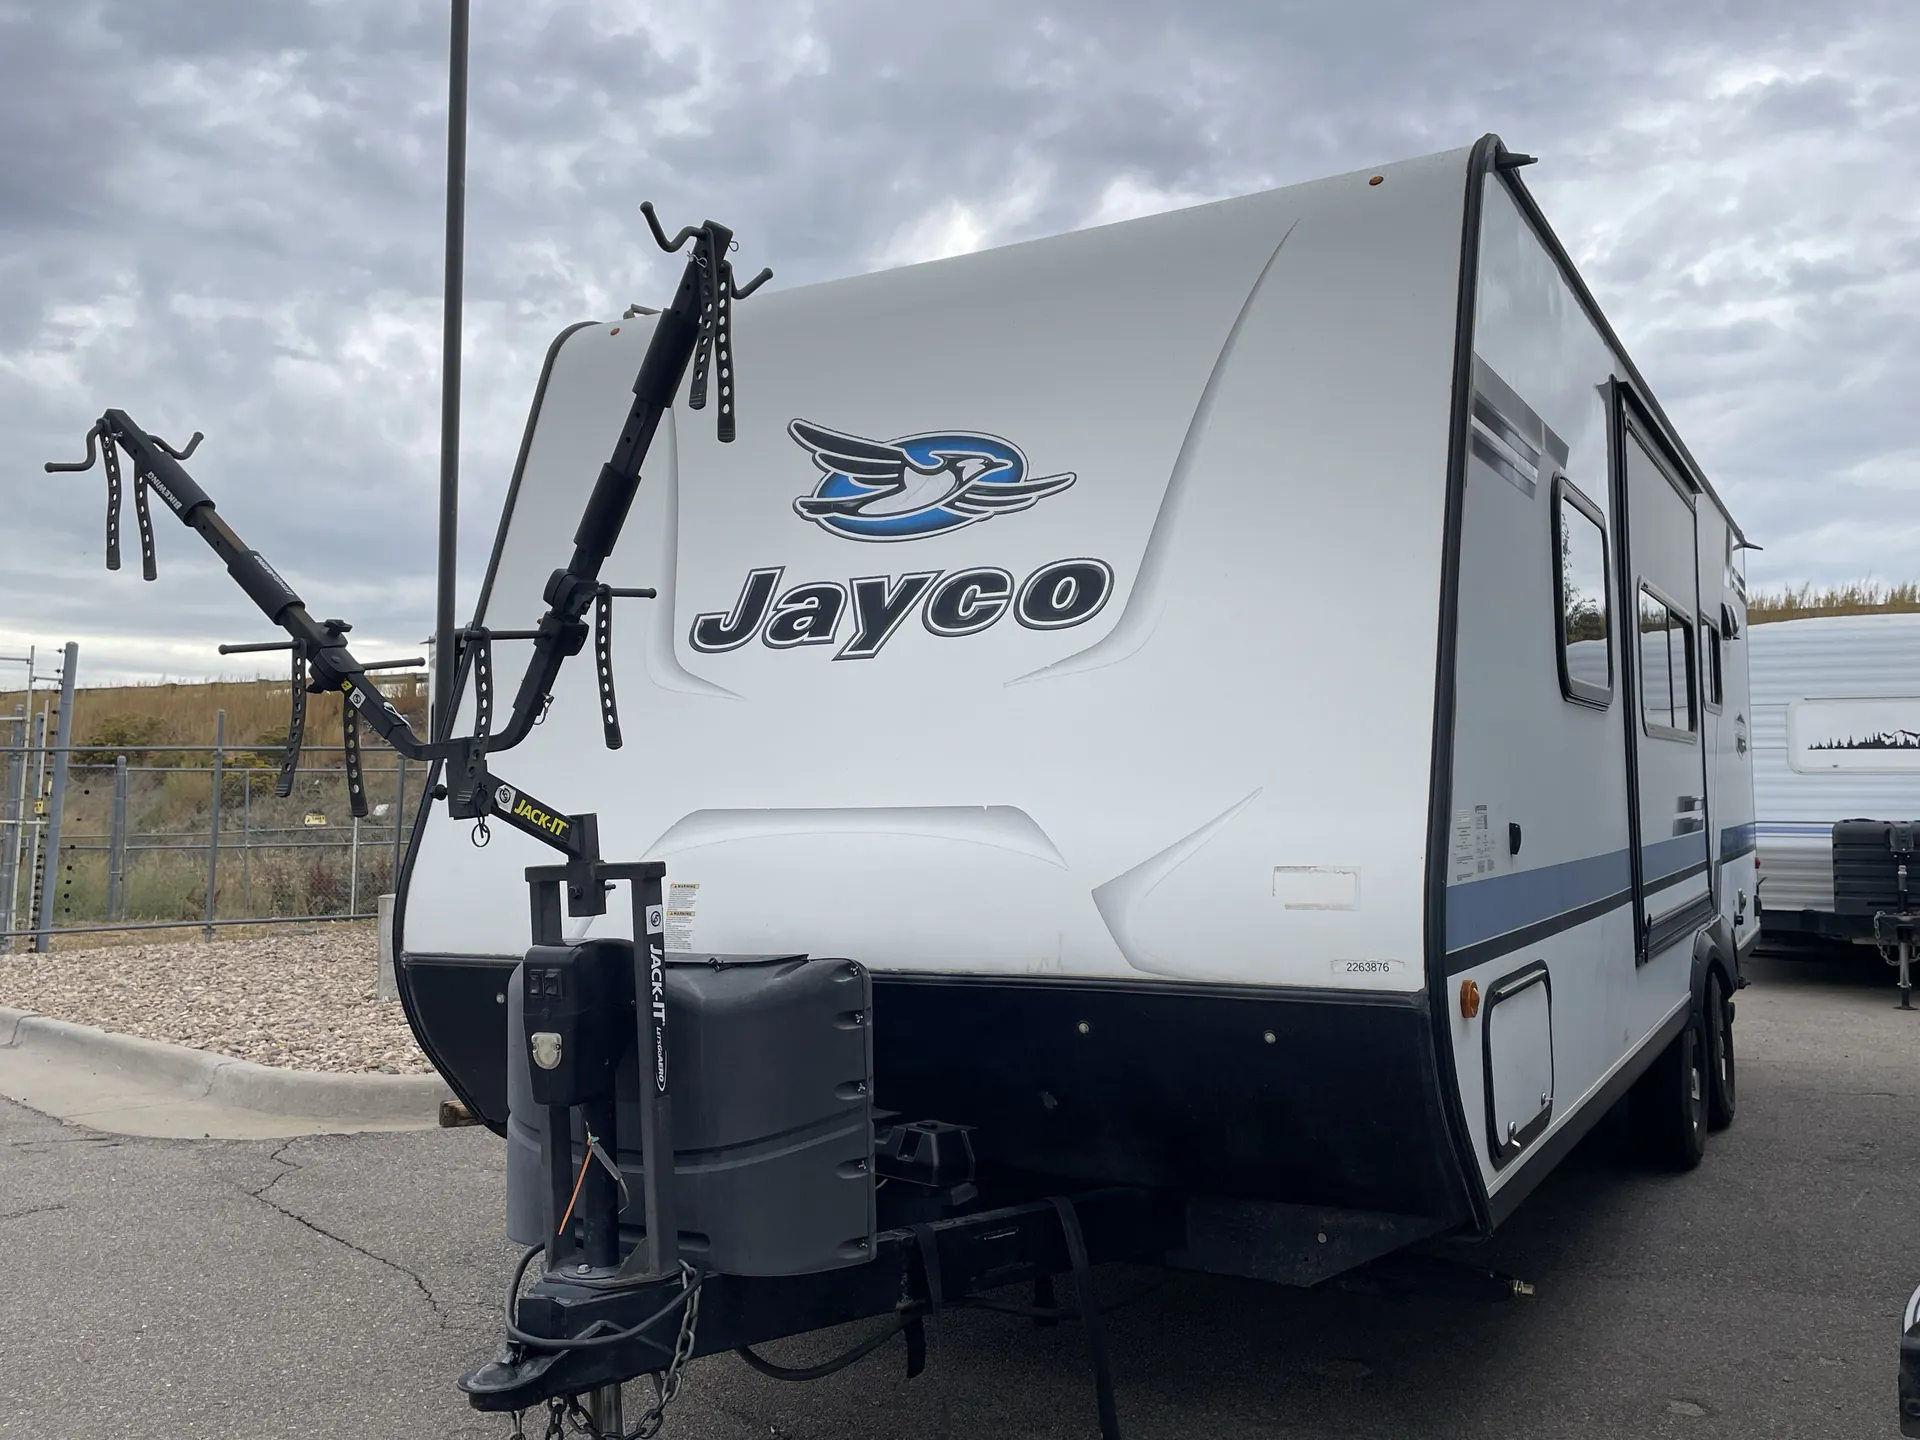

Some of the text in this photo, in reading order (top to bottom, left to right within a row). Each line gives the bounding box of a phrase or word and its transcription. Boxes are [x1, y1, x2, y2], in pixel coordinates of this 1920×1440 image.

[147, 471, 183, 510] BIKEWING
[689, 557, 1115, 661] Jayco
[514, 799, 567, 836] JACK-IT
[650, 943, 665, 1022] JACK-IT
[1346, 962, 1390, 972] 2263876
